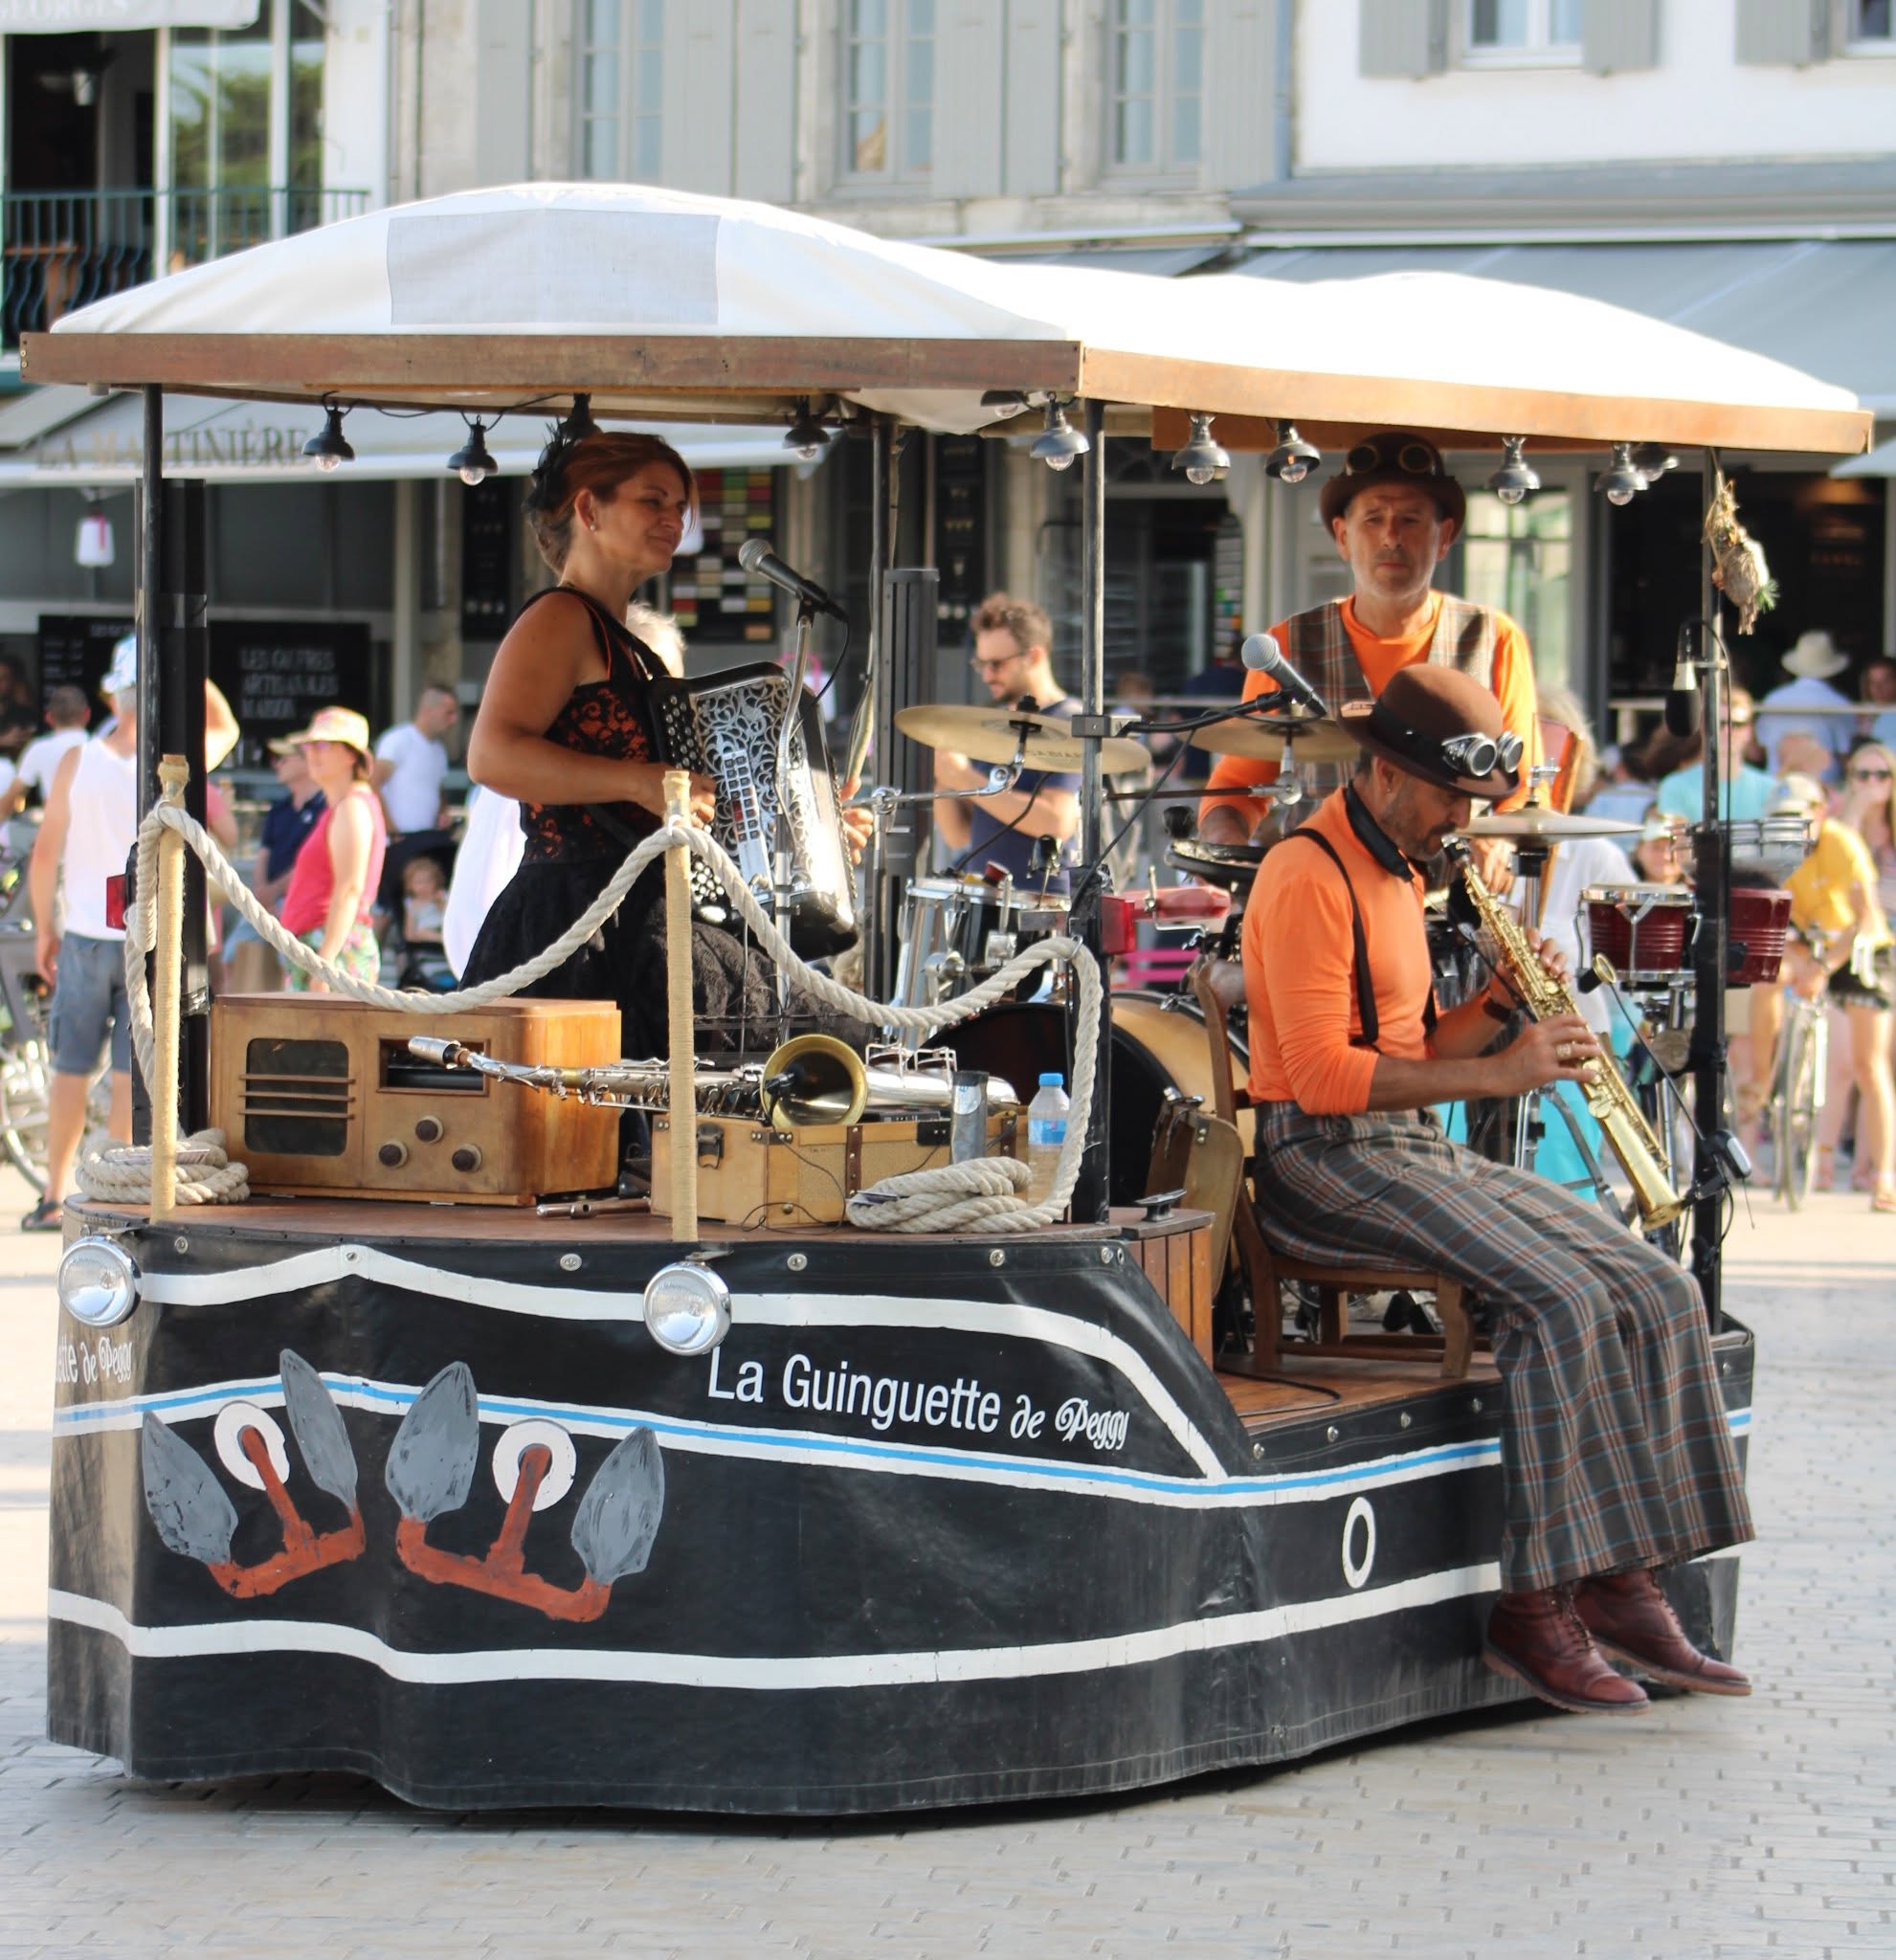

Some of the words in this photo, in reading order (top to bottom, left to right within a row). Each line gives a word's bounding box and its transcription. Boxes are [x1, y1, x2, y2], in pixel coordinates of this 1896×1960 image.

[37, 434, 78, 470] LA
[92, 418, 309, 469] MATINIÈRE
[80, 1342, 99, 1385] de
[707, 1347, 764, 1404] La
[782, 1354, 1001, 1431] Guinguette
[1010, 1394, 1046, 1439] de
[1055, 1396, 1130, 1451] Peggy
